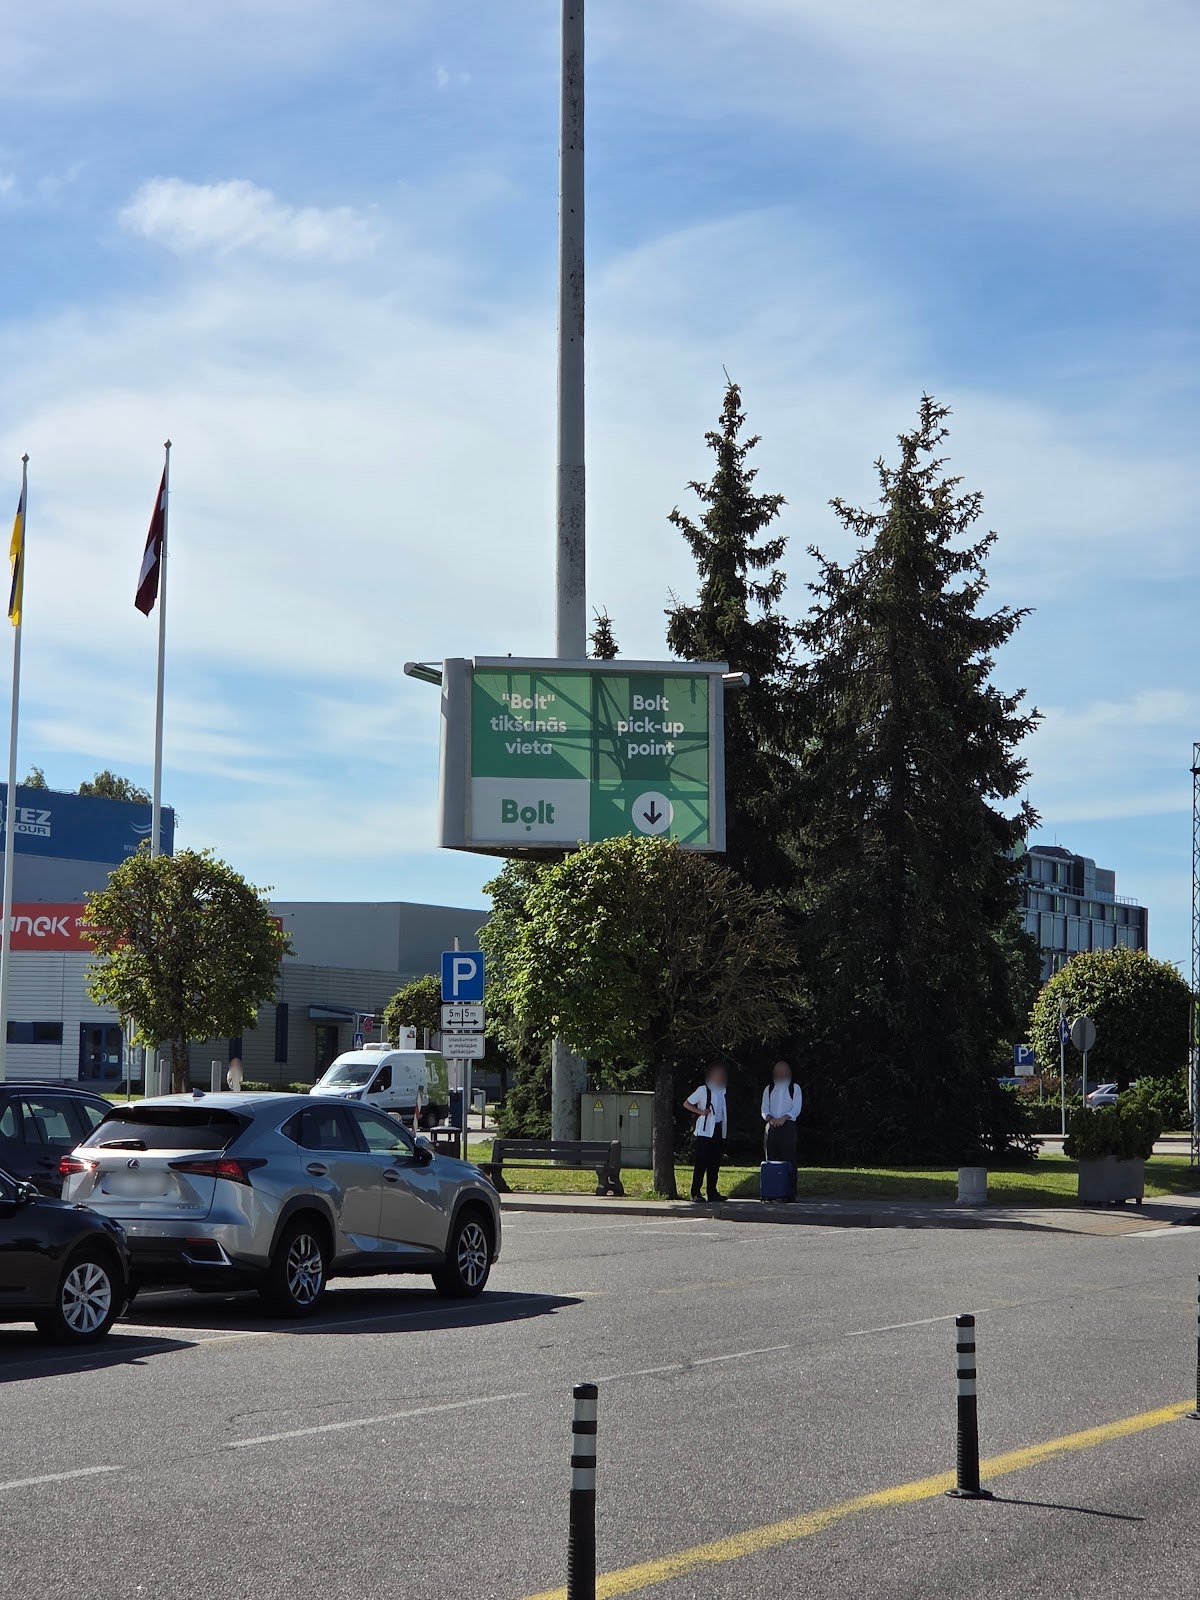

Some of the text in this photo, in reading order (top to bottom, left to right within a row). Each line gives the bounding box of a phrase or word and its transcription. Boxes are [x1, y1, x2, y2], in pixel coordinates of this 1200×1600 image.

[502, 693, 556, 710] "Bolt"
[632, 694, 669, 712] Bolt
[490, 714, 567, 733] tikšanās
[617, 716, 685, 737] pick-up
[505, 737, 553, 755] vieta
[627, 740, 675, 759] point
[501, 798, 555, 832] Bolt
[13, 824, 46, 835] OUR
[452, 957, 477, 996] P
[1018, 1047, 1029, 1063] P
